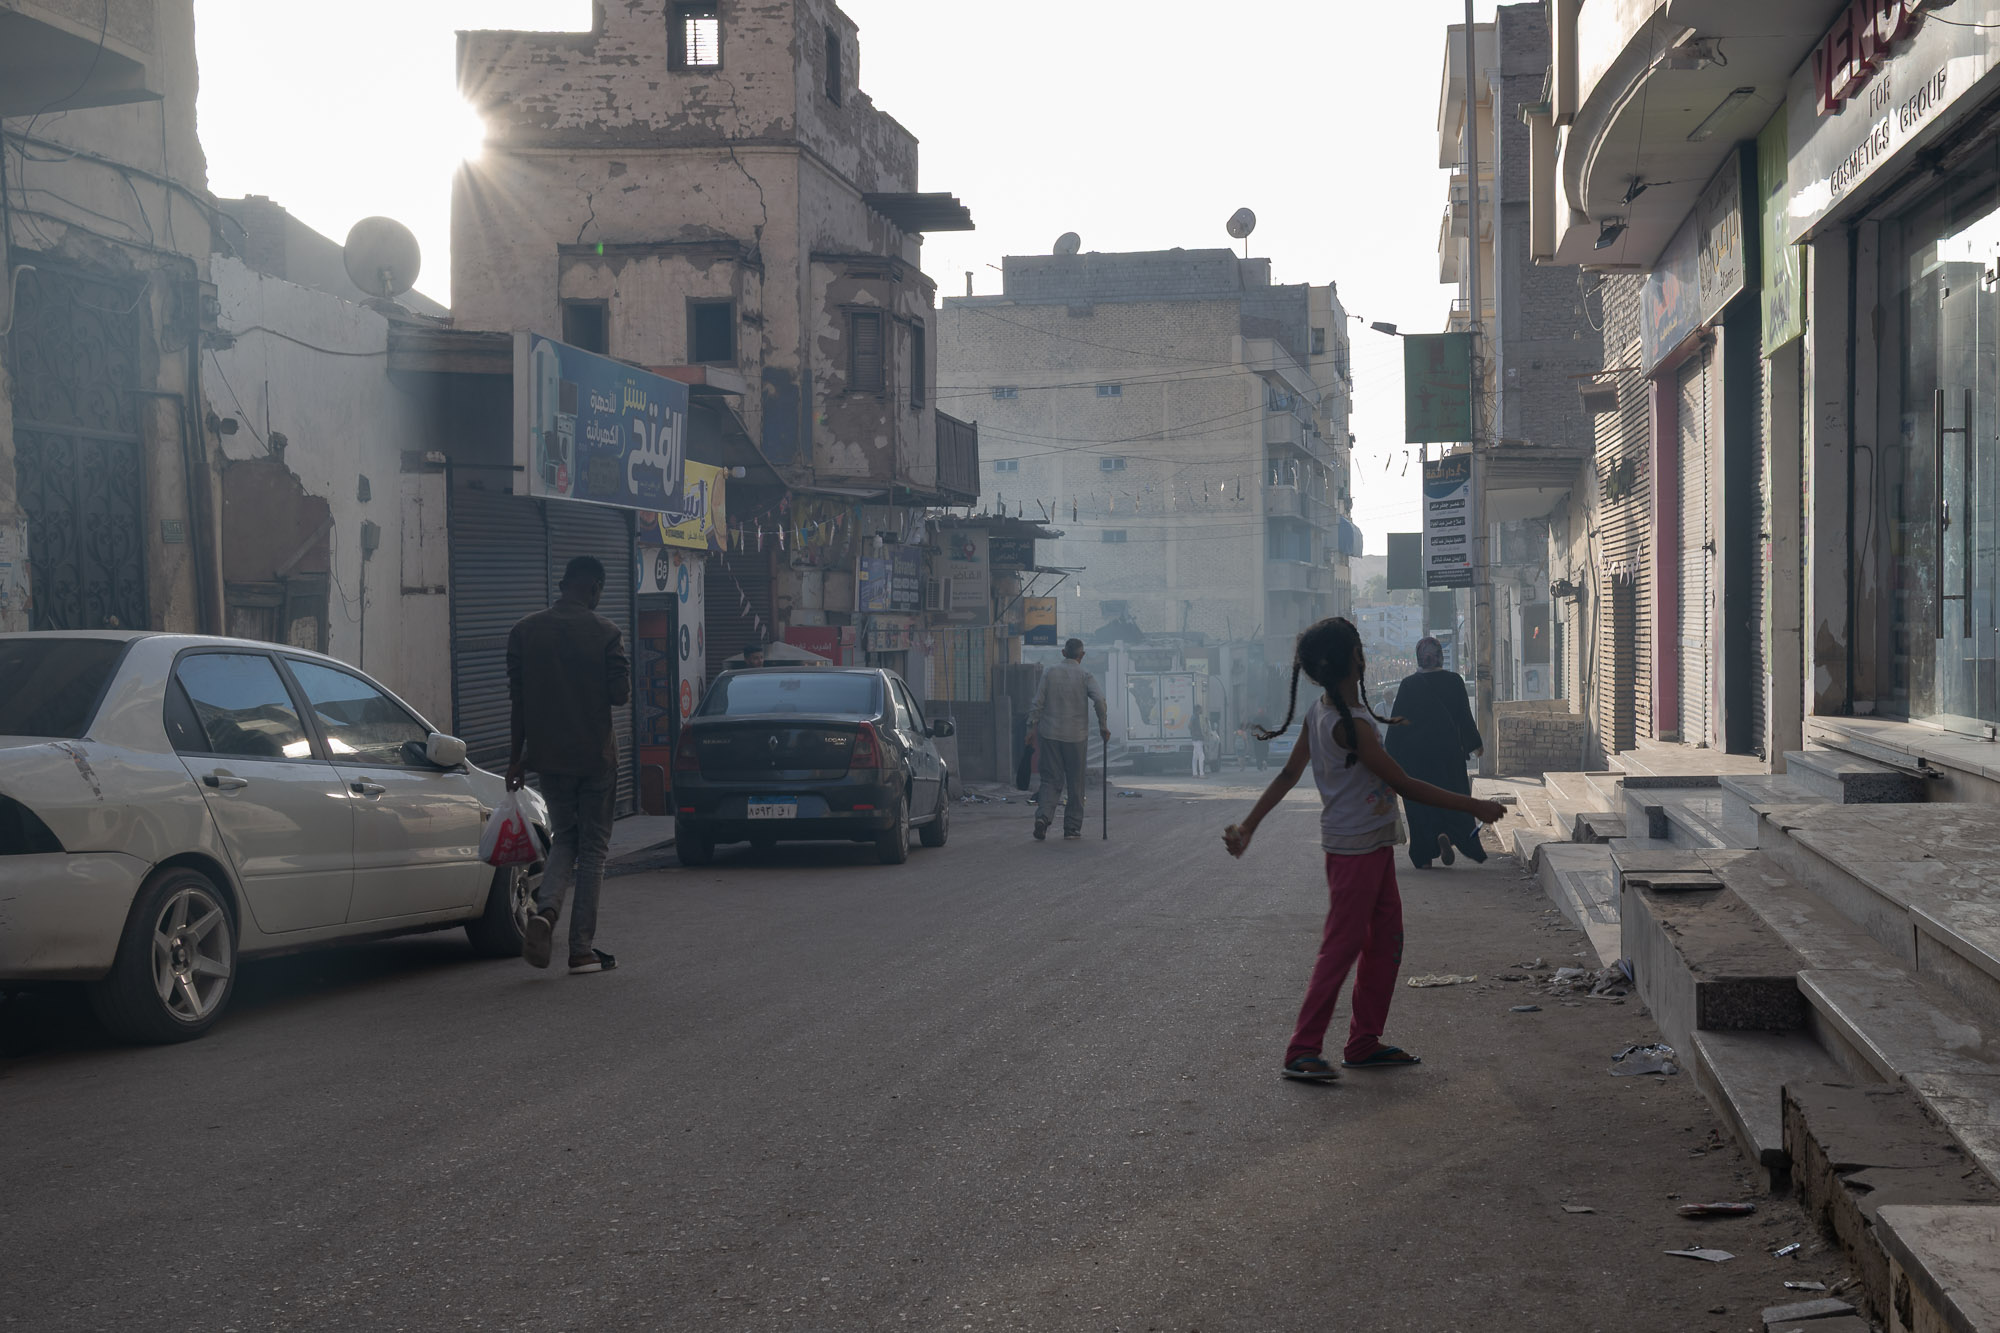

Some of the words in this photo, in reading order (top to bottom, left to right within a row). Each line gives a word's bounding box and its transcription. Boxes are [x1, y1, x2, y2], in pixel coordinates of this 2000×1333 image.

[1812, 0, 1921, 117] VENU
[1869, 74, 1890, 117] FOR
[1830, 120, 1890, 197] COSMETICS
[1899, 67, 1946, 133] GROUP
[621, 377, 647, 416] سنتر
[627, 402, 683, 497] الفتح
